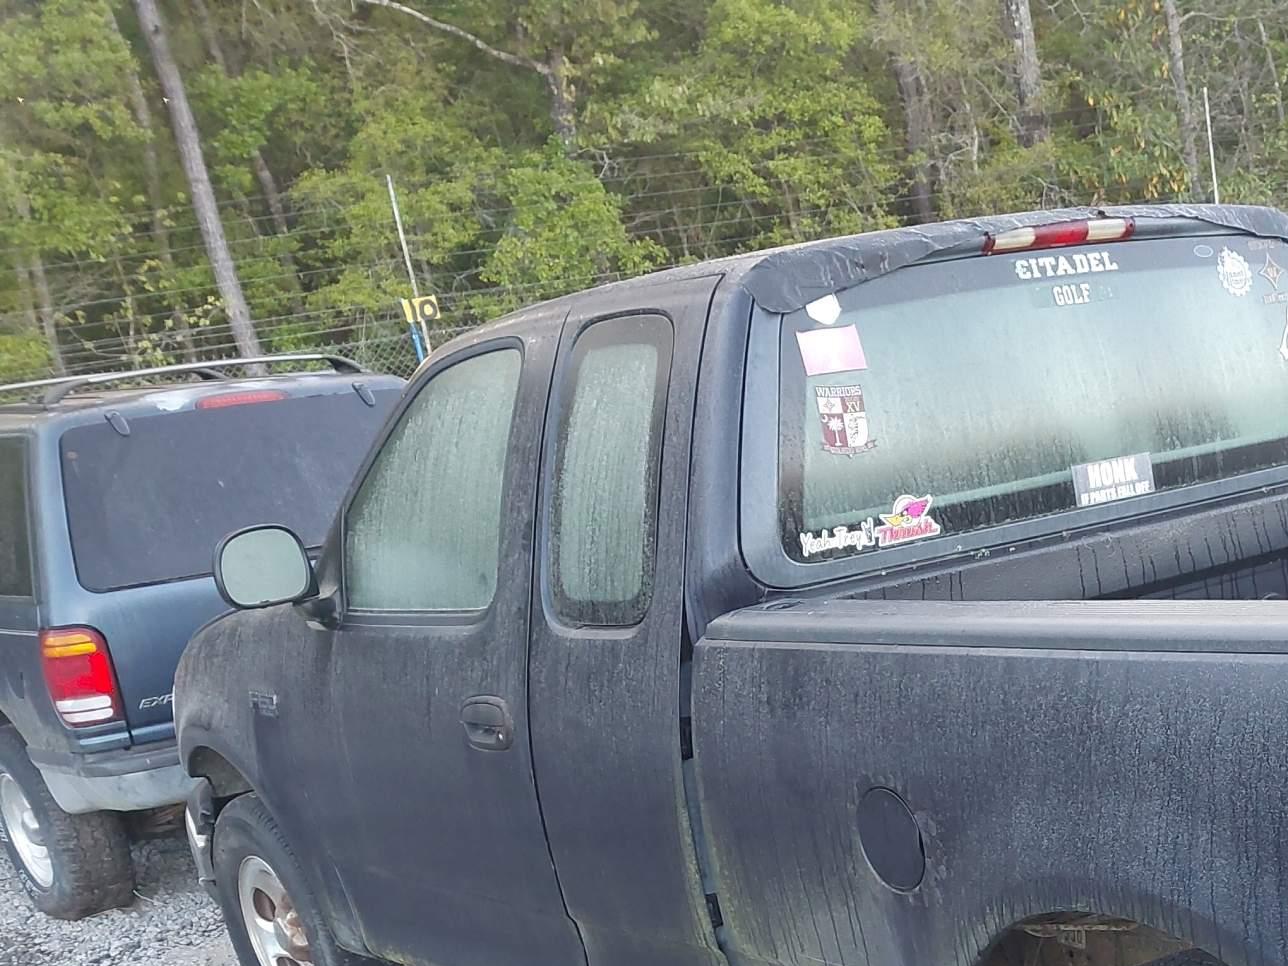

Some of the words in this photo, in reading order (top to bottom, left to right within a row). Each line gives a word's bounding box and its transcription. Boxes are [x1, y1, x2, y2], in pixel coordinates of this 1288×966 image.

[1053, 283, 1091, 306] GOLF
[408, 298, 438, 320] 10
[816, 386, 861, 398] WARRIORS
[846, 401, 860, 413] XV
[1087, 457, 1138, 489] HONK
